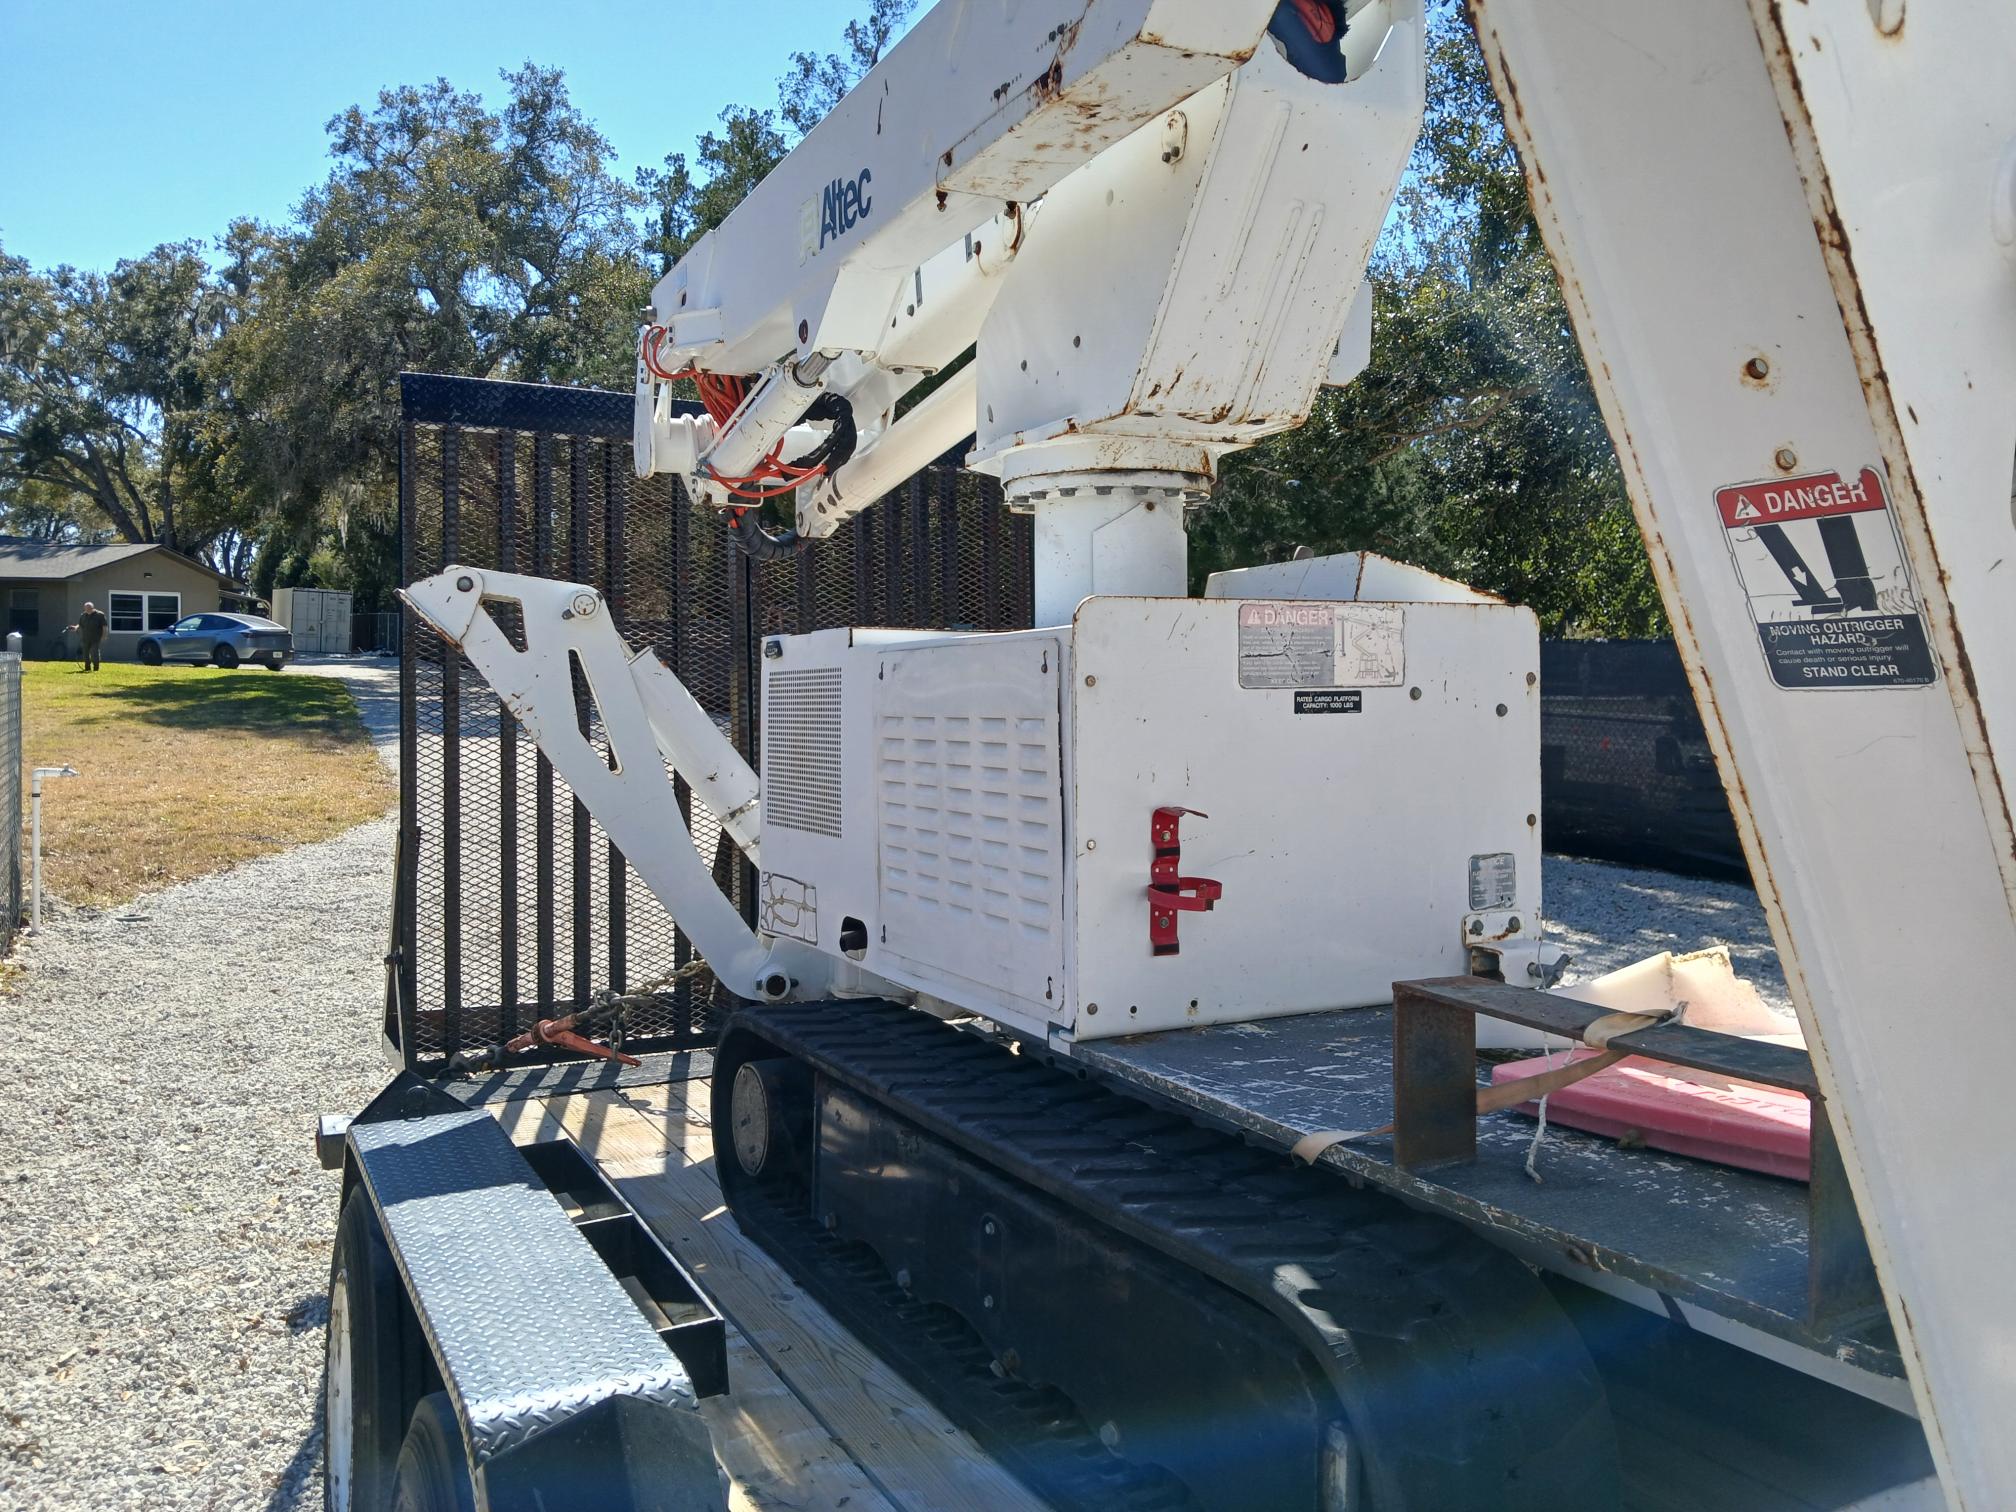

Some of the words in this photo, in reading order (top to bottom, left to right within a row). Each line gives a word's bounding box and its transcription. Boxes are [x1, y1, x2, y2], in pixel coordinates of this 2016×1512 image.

[820, 168, 872, 250] Altec
[1764, 481, 1868, 514] DANGER
[1264, 609, 1329, 625] DANGER
[1769, 623, 1820, 637] MOVING
[1823, 618, 1905, 634] OUTRIGGER
[1811, 633, 1867, 646] HAZARD
[1807, 648, 1824, 656] with
[1825, 647, 1855, 656] moving
[1856, 645, 1894, 655] outrigger
[1803, 656, 1826, 664] death
[1837, 655, 1868, 663] serious
[1869, 654, 1894, 663] injury.
[1803, 666, 1848, 678] STAND
[1851, 664, 1900, 677] CLEAR
